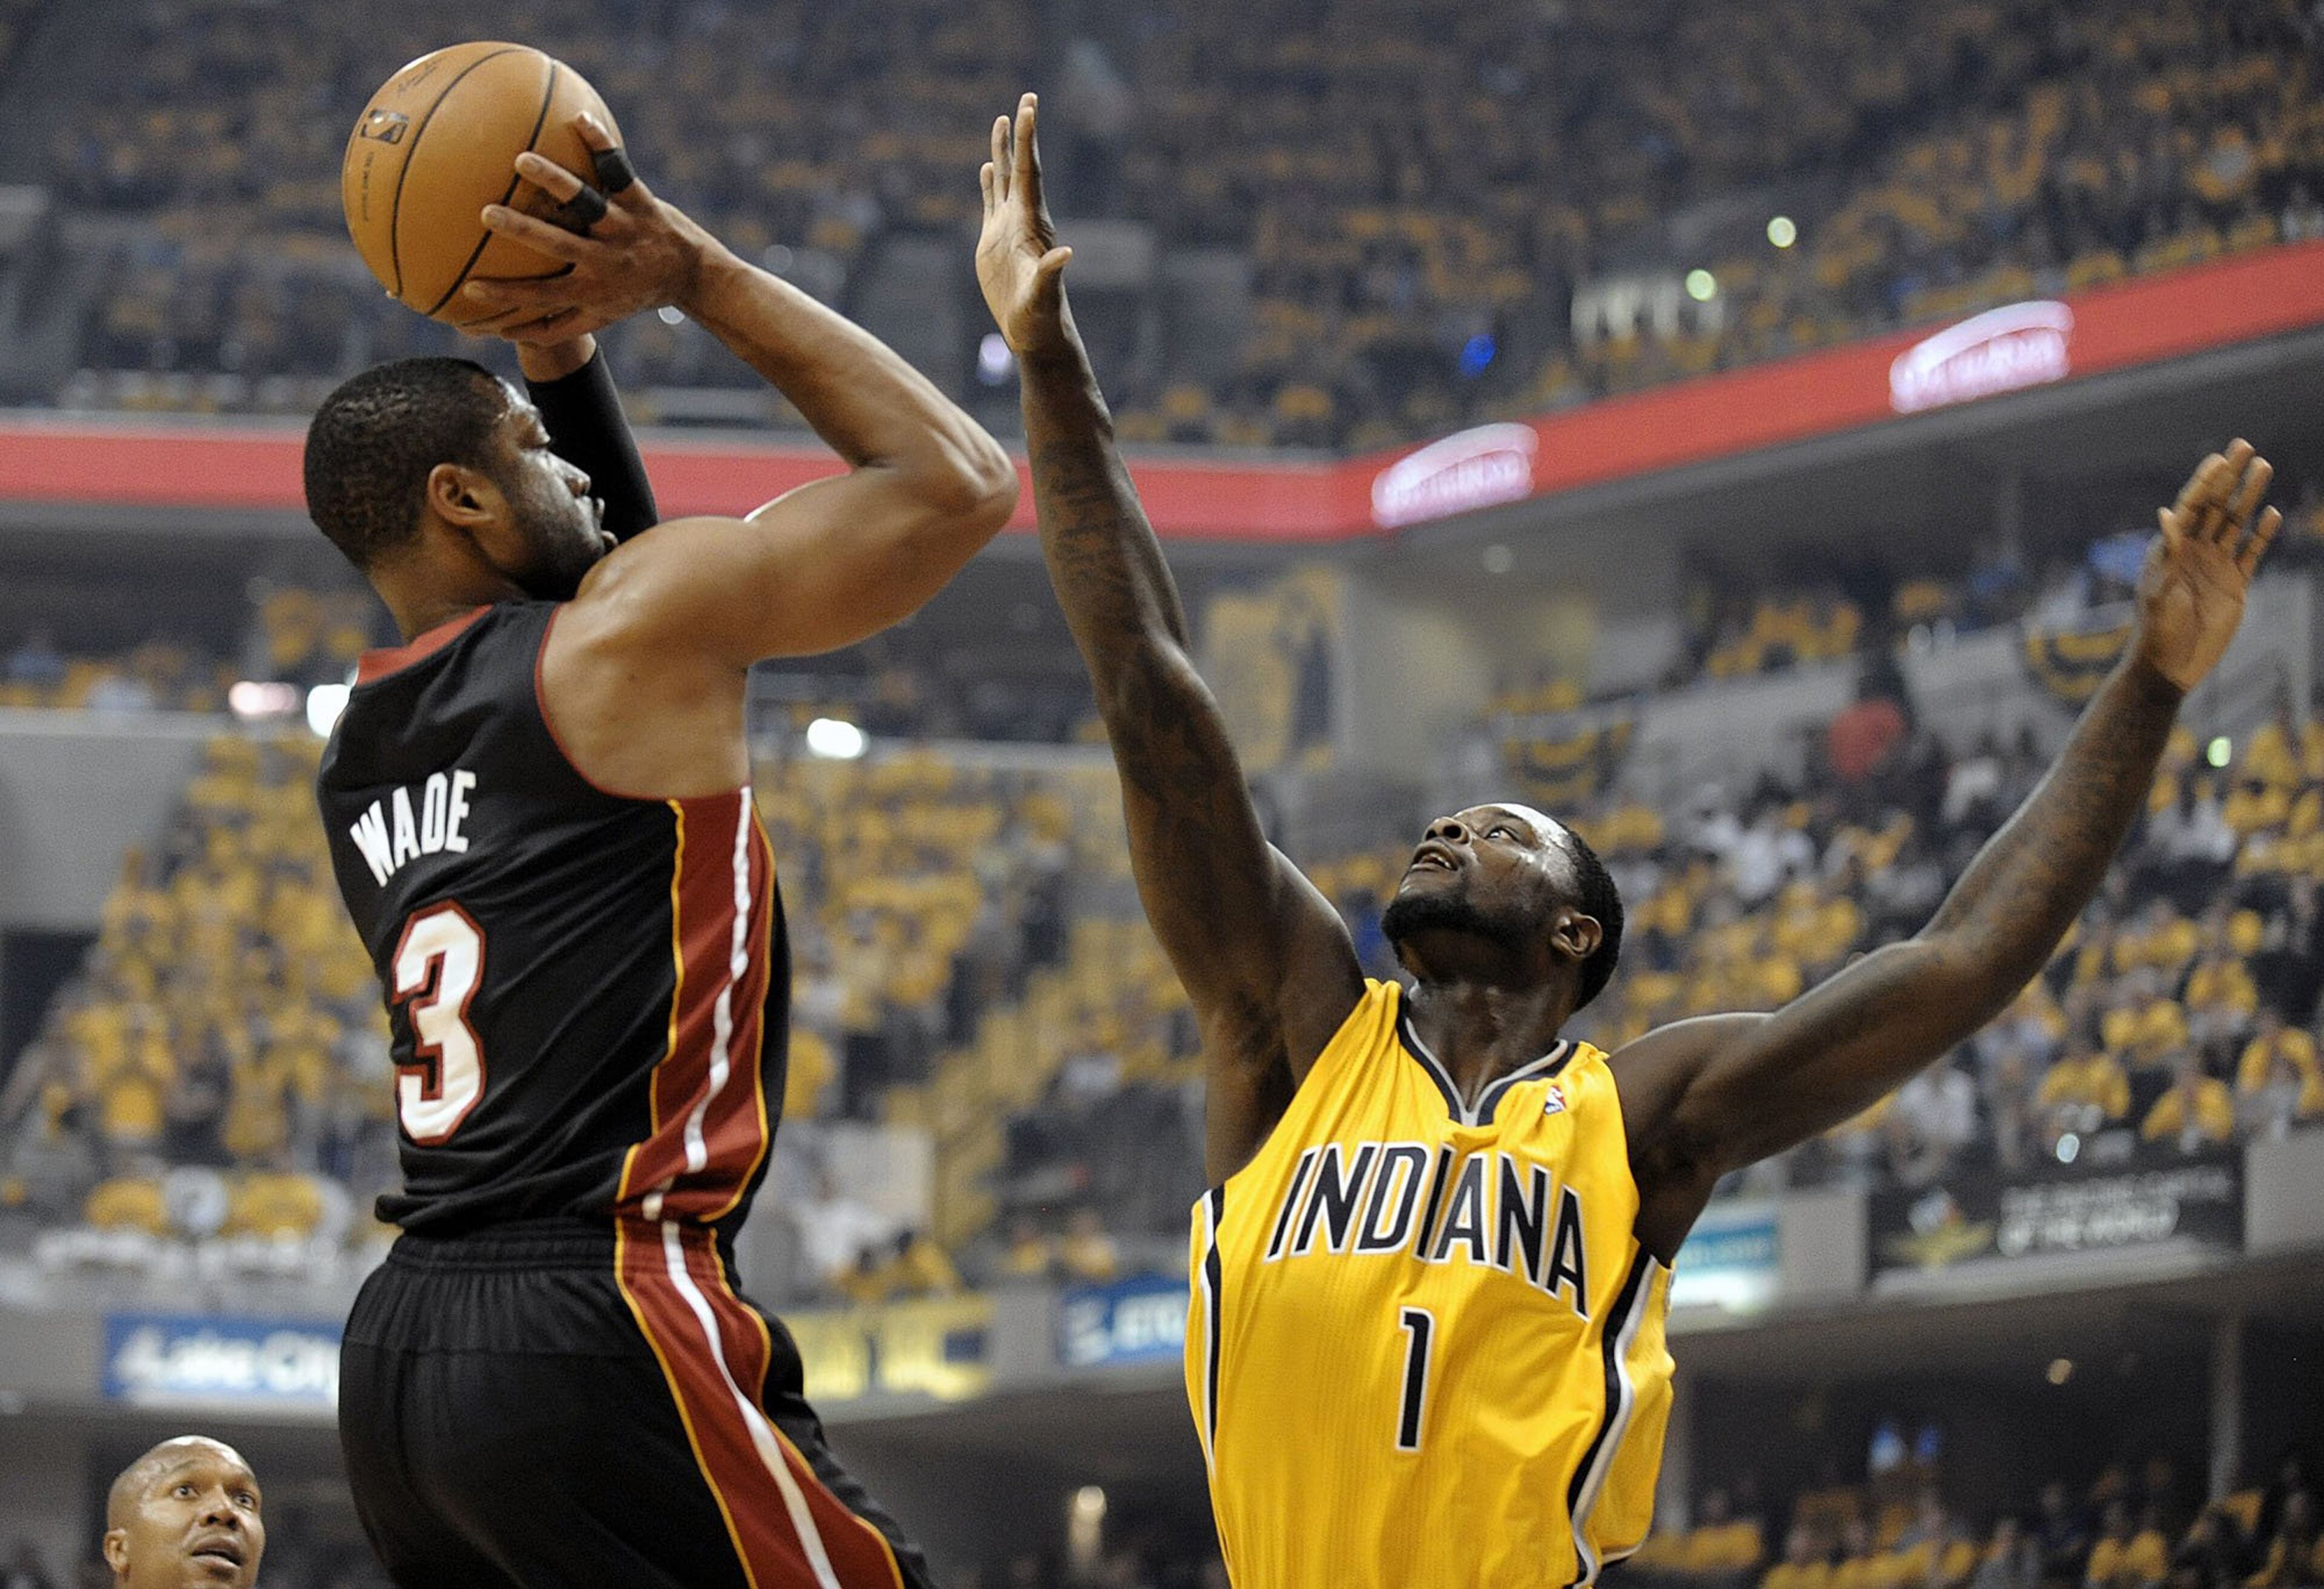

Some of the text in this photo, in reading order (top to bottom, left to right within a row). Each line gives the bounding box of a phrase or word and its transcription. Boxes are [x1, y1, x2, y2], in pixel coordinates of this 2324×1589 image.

[349, 769, 476, 887] WADE
[391, 898, 486, 1146] 3
[1263, 1140, 1591, 1324] INDIANA
[1394, 1305, 1436, 1452] 1
